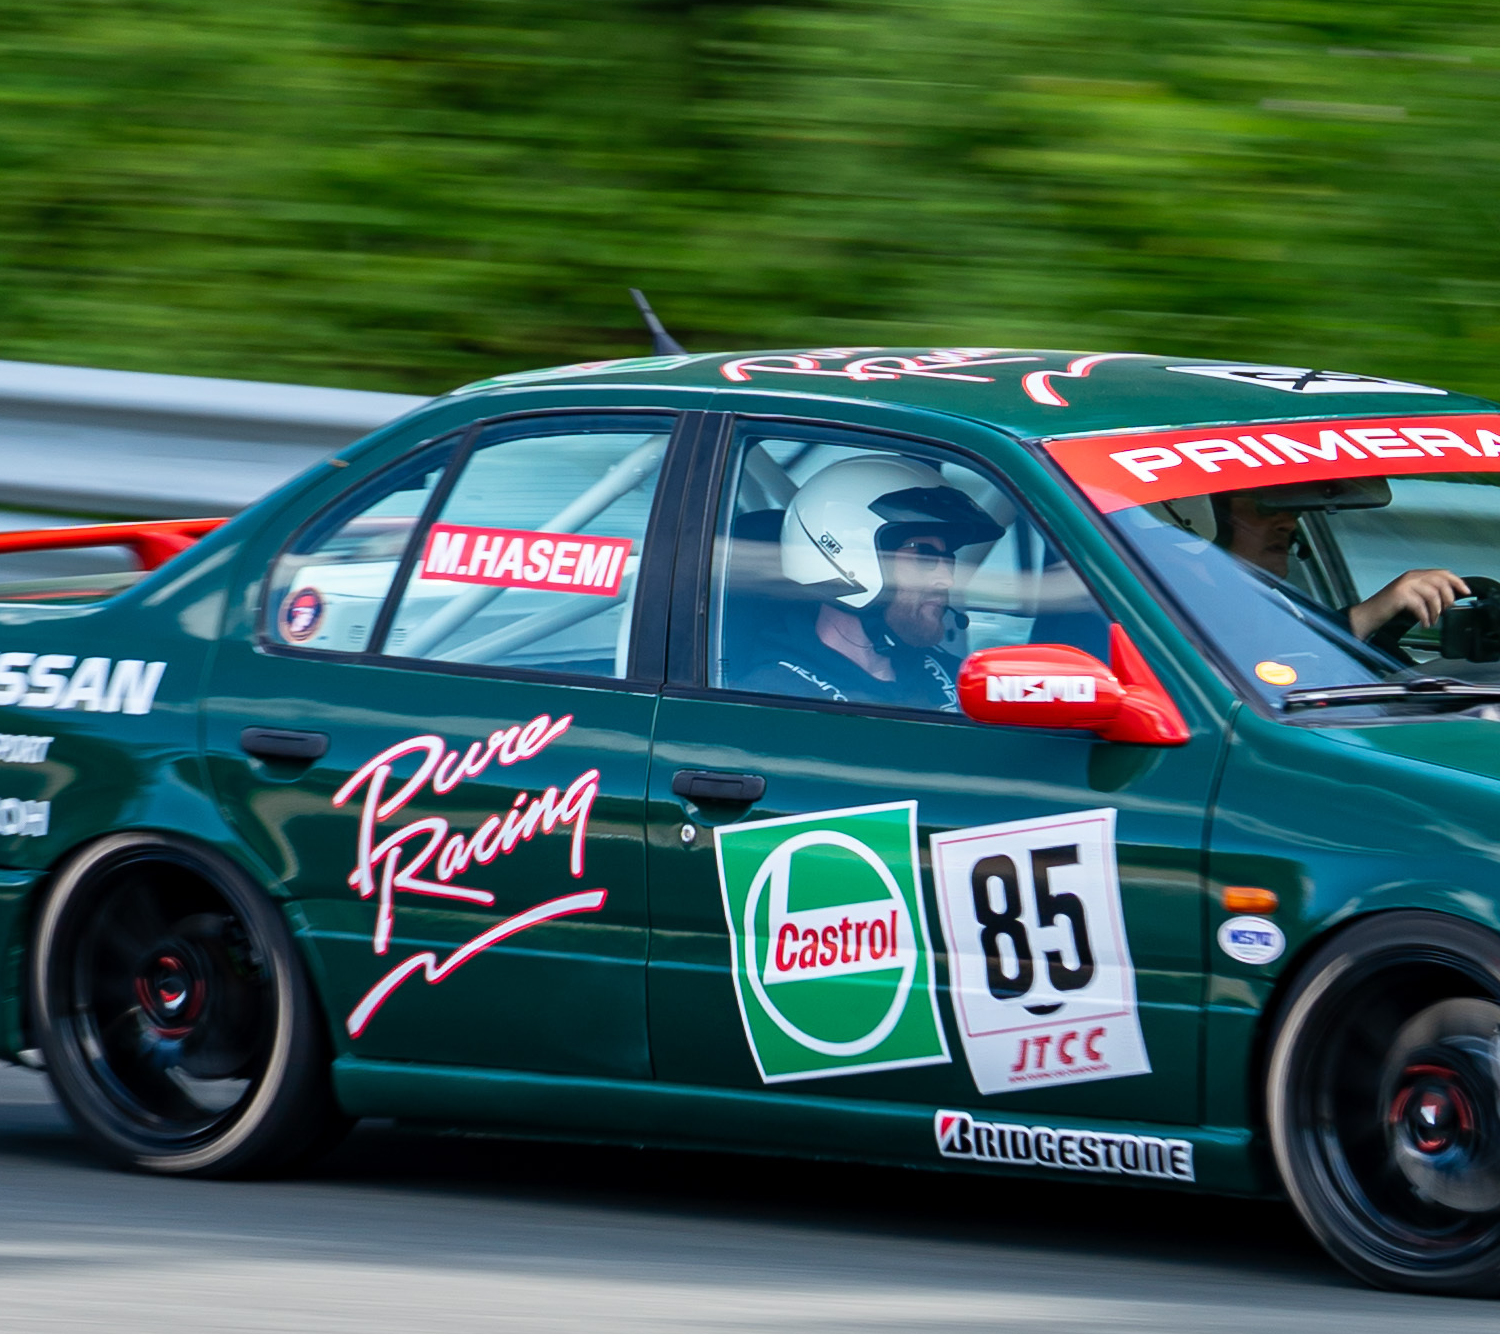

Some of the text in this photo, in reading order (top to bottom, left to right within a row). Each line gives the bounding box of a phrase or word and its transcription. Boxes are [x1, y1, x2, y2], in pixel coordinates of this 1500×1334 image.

[426, 531, 624, 588] M.HASEMI
[820, 533, 842, 556] OMP
[986, 675, 1097, 702] NISMO
[332, 713, 573, 899] Pure
[348, 768, 600, 955] Racing
[775, 909, 898, 972] Castrol
[971, 843, 1094, 1001] 85
[1010, 1026, 1107, 1073] JTCC
[940, 1115, 1190, 1177] BRIDGESTONE
